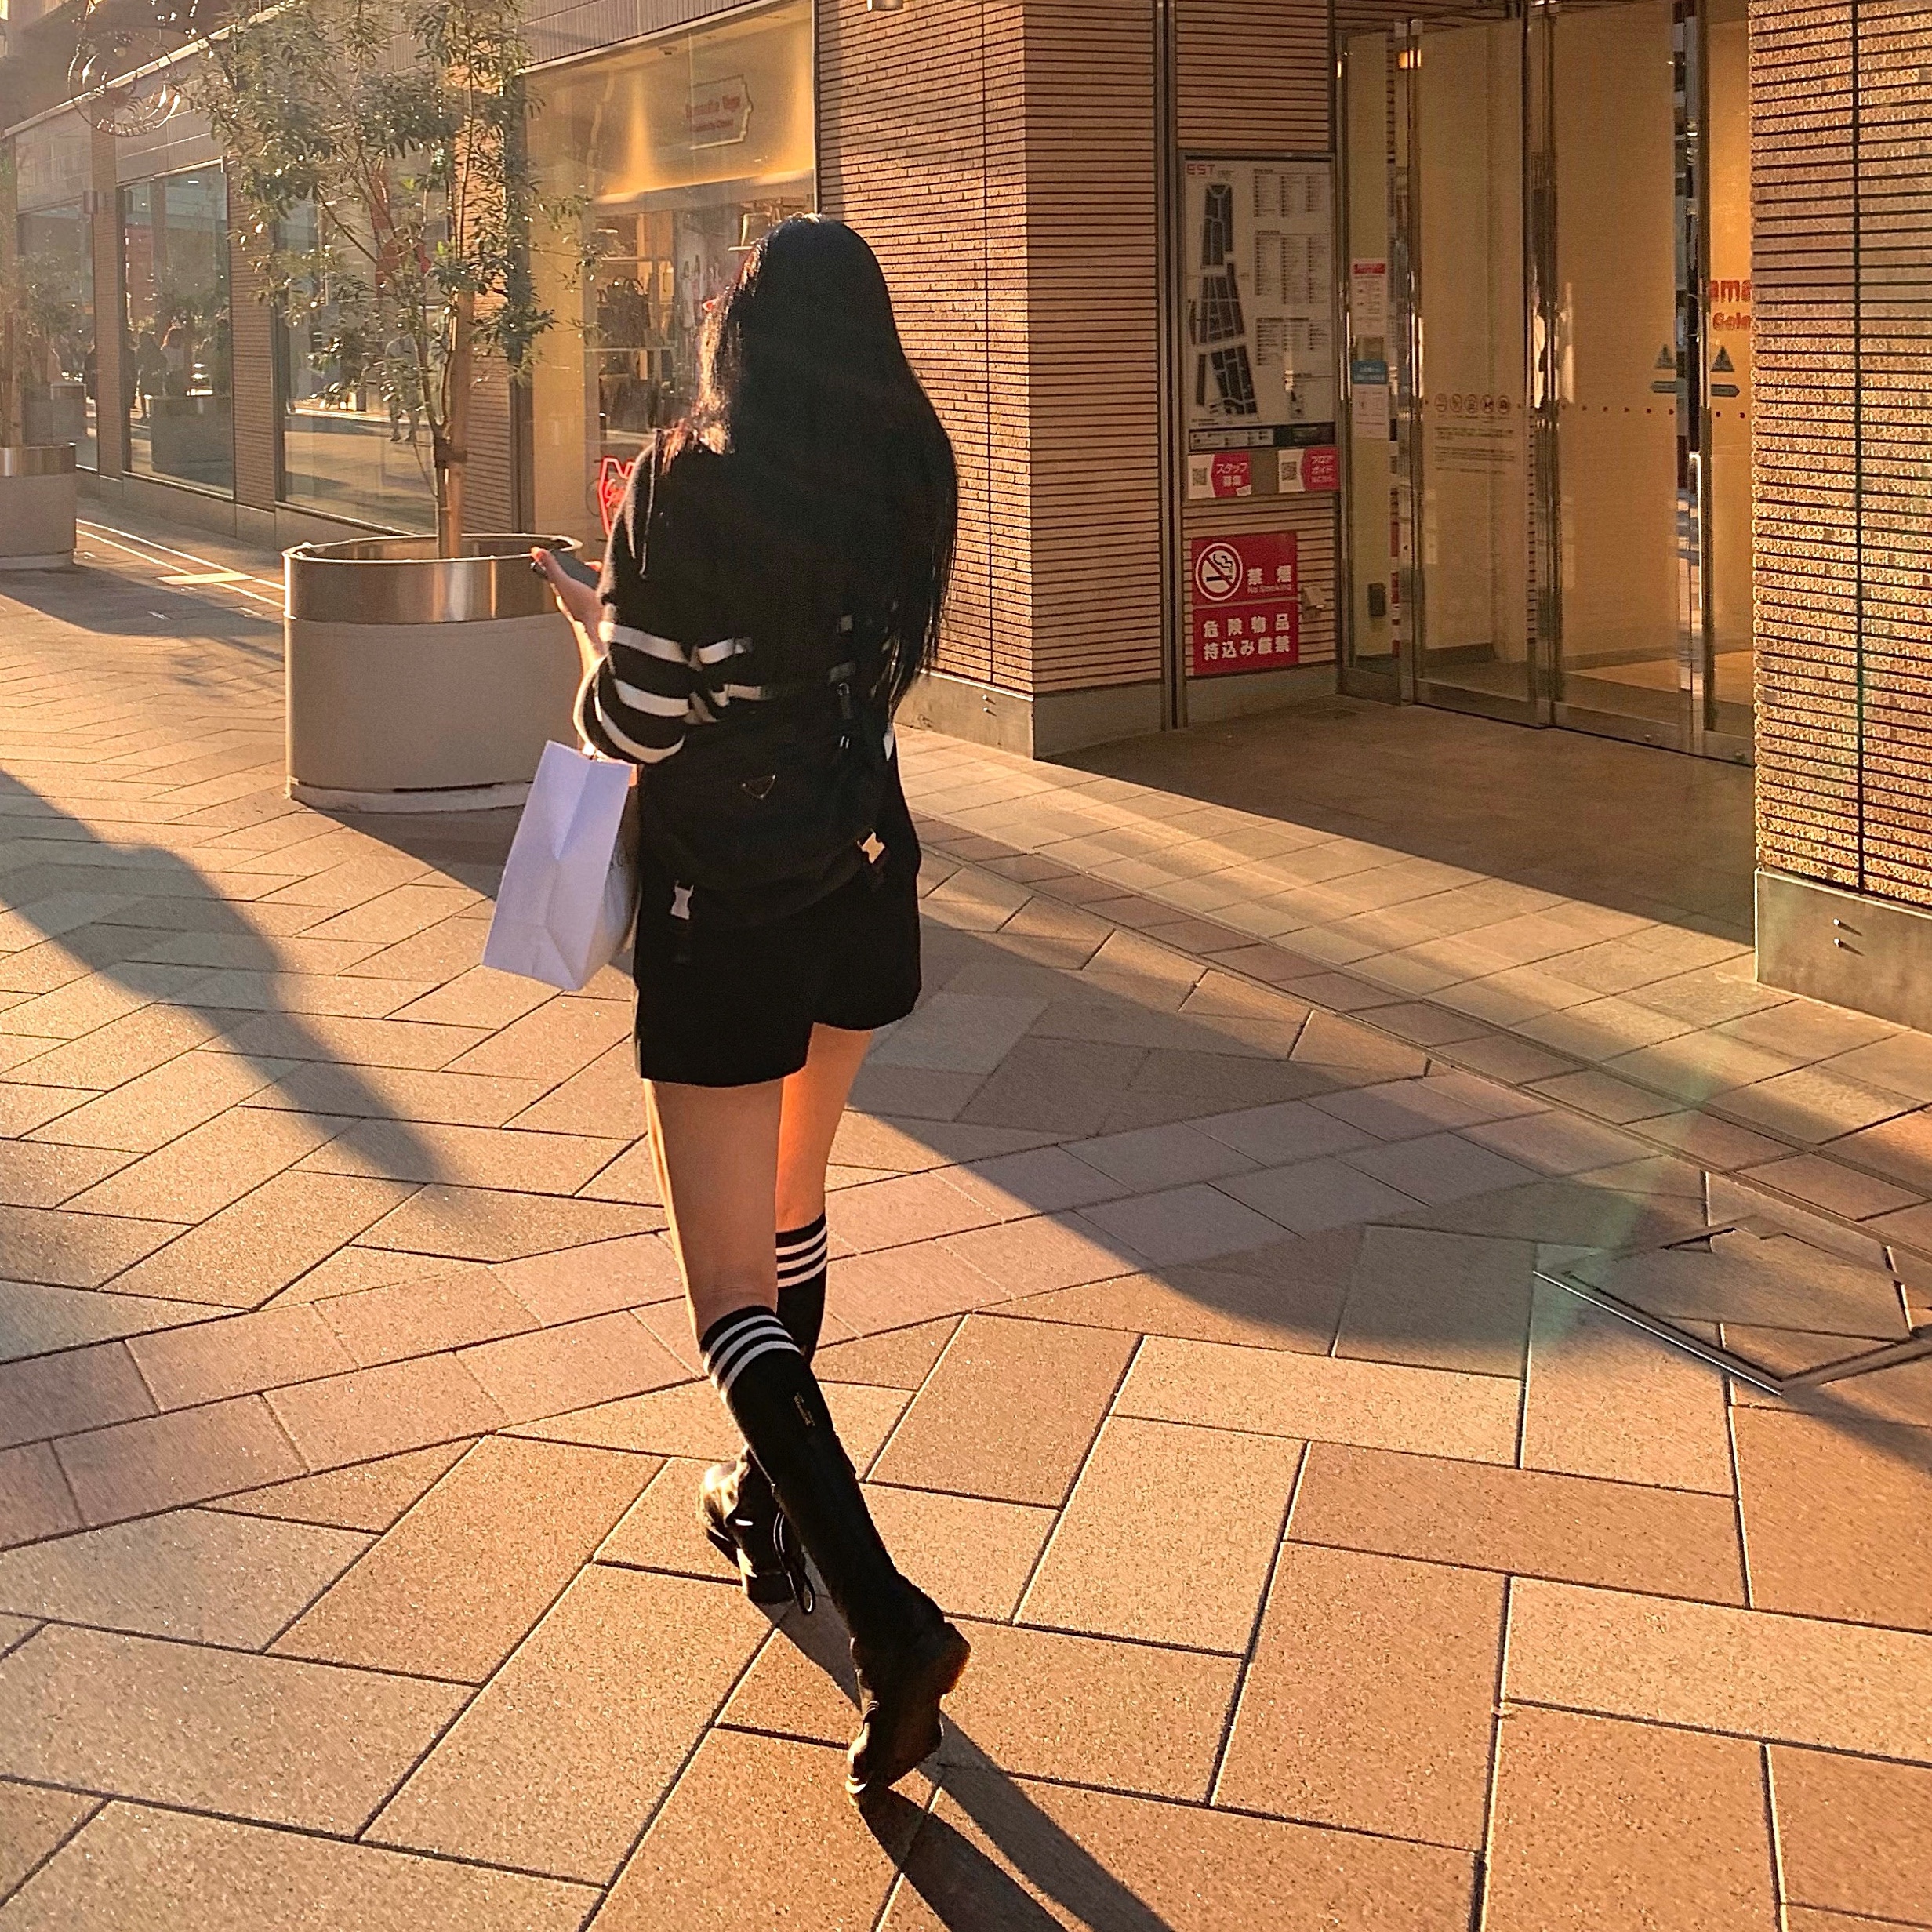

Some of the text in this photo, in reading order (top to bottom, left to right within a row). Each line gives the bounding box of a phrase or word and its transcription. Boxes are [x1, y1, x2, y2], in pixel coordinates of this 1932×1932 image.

[1186, 164, 1215, 176] EST
[1204, 635, 1290, 660] 持込み厳禁
